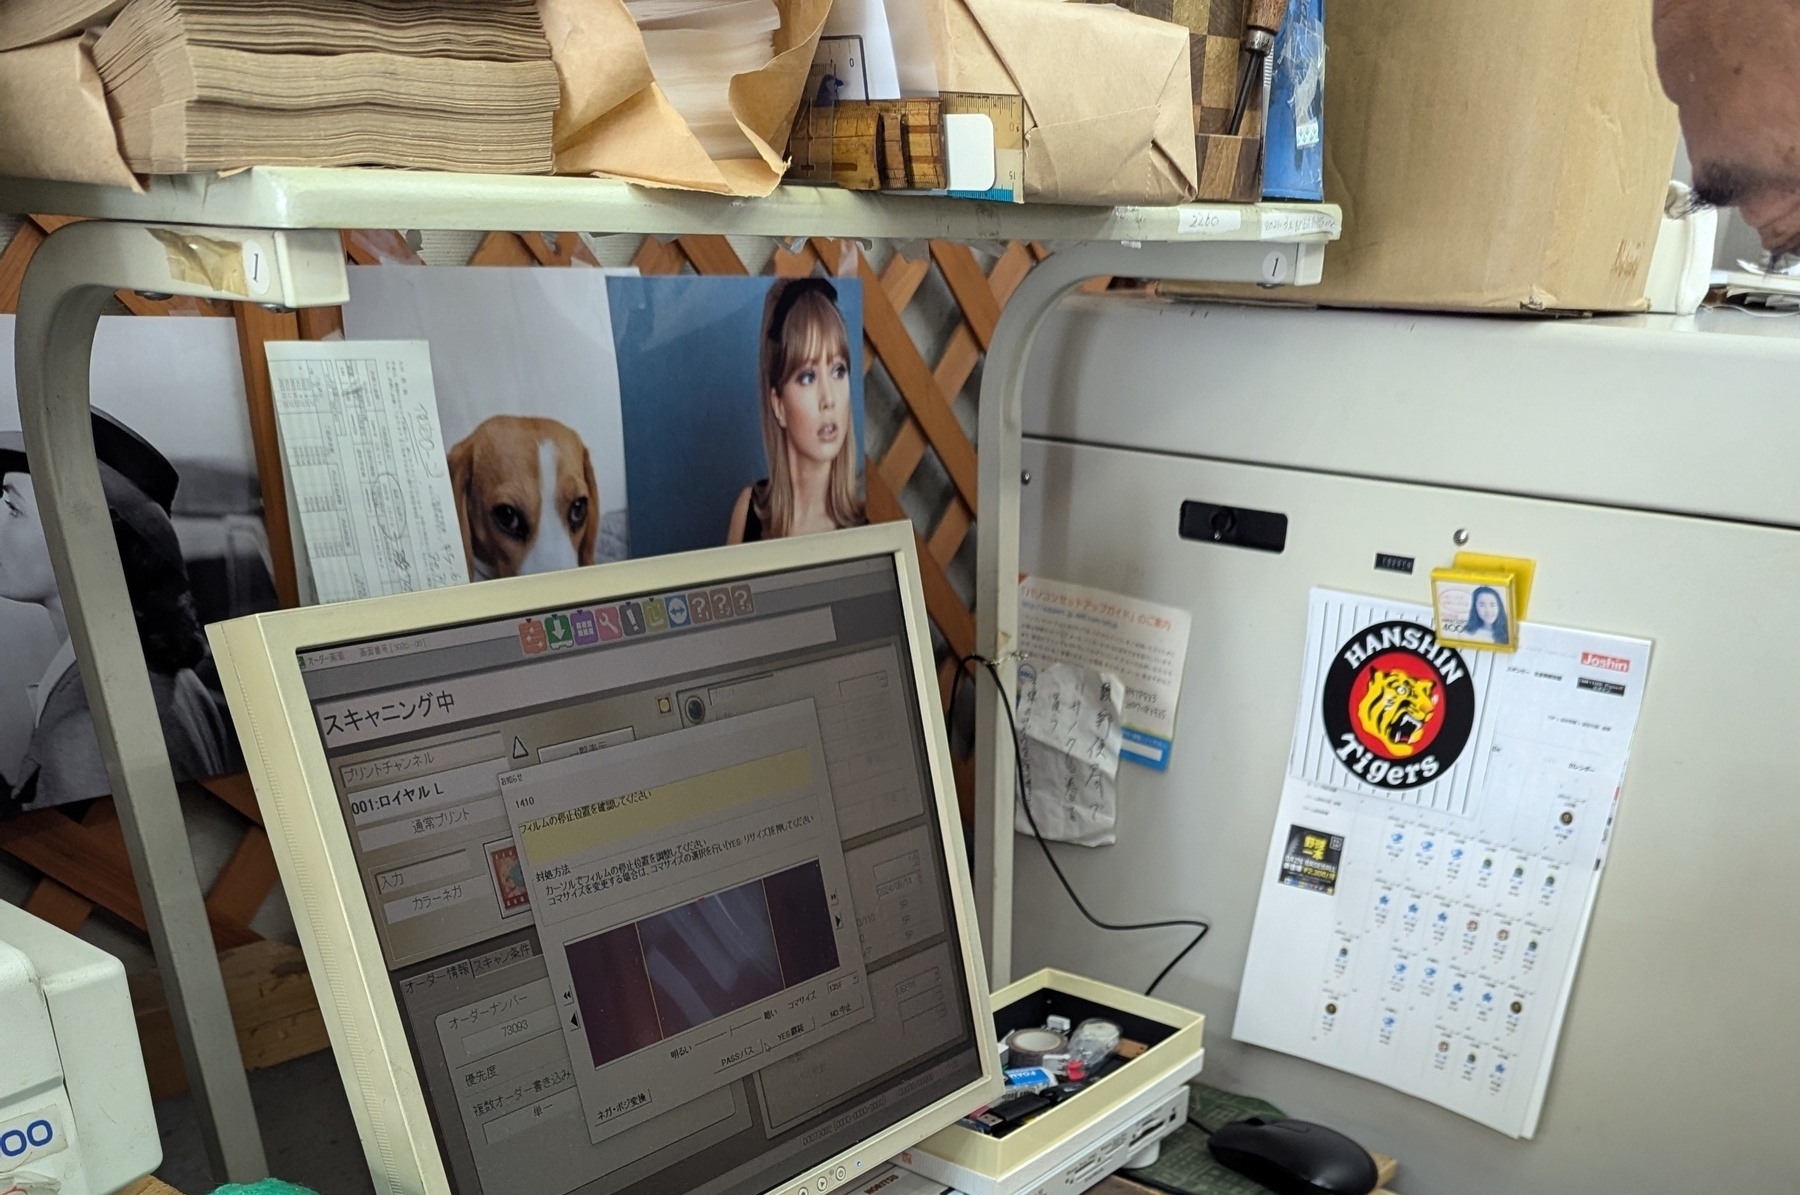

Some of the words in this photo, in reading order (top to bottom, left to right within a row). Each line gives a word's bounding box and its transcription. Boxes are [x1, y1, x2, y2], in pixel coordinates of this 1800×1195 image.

[1343, 625, 1465, 685] HANSHIN
[1583, 653, 1628, 672] Joshin
[324, 690, 454, 736] スキャニング中
[344, 752, 435, 783] プリントチャンネル
[1335, 733, 1440, 784] Tigers
[501, 773, 523, 786] お知らせ
[351, 783, 430, 816] 001:ロイヤル
[436, 782, 444, 795] L
[515, 797, 535, 809] 1410
[412, 808, 470, 834] 通常プリント
[518, 790, 652, 835] フィルムの停止位置を確認してください
[535, 863, 571, 883] 対処方法
[545, 838, 707, 896] カーソルでフィルムの停止位置を調整してください
[380, 872, 404, 890] 入力
[412, 885, 462, 911] カラーネガ
[472, 942, 531, 972] スキャン条件
[404, 961, 470, 994] オーダー情報
[449, 994, 528, 1029] オーダーナンバー
[501, 1019, 529, 1038] 73093
[670, 1046, 692, 1059] 明るい
[464, 1065, 498, 1088] 優先度
[473, 1069, 572, 1118] 複数オーダー書き込み
[532, 1103, 554, 1118] 単一
[864, 1174, 899, 1195] NORITSU
